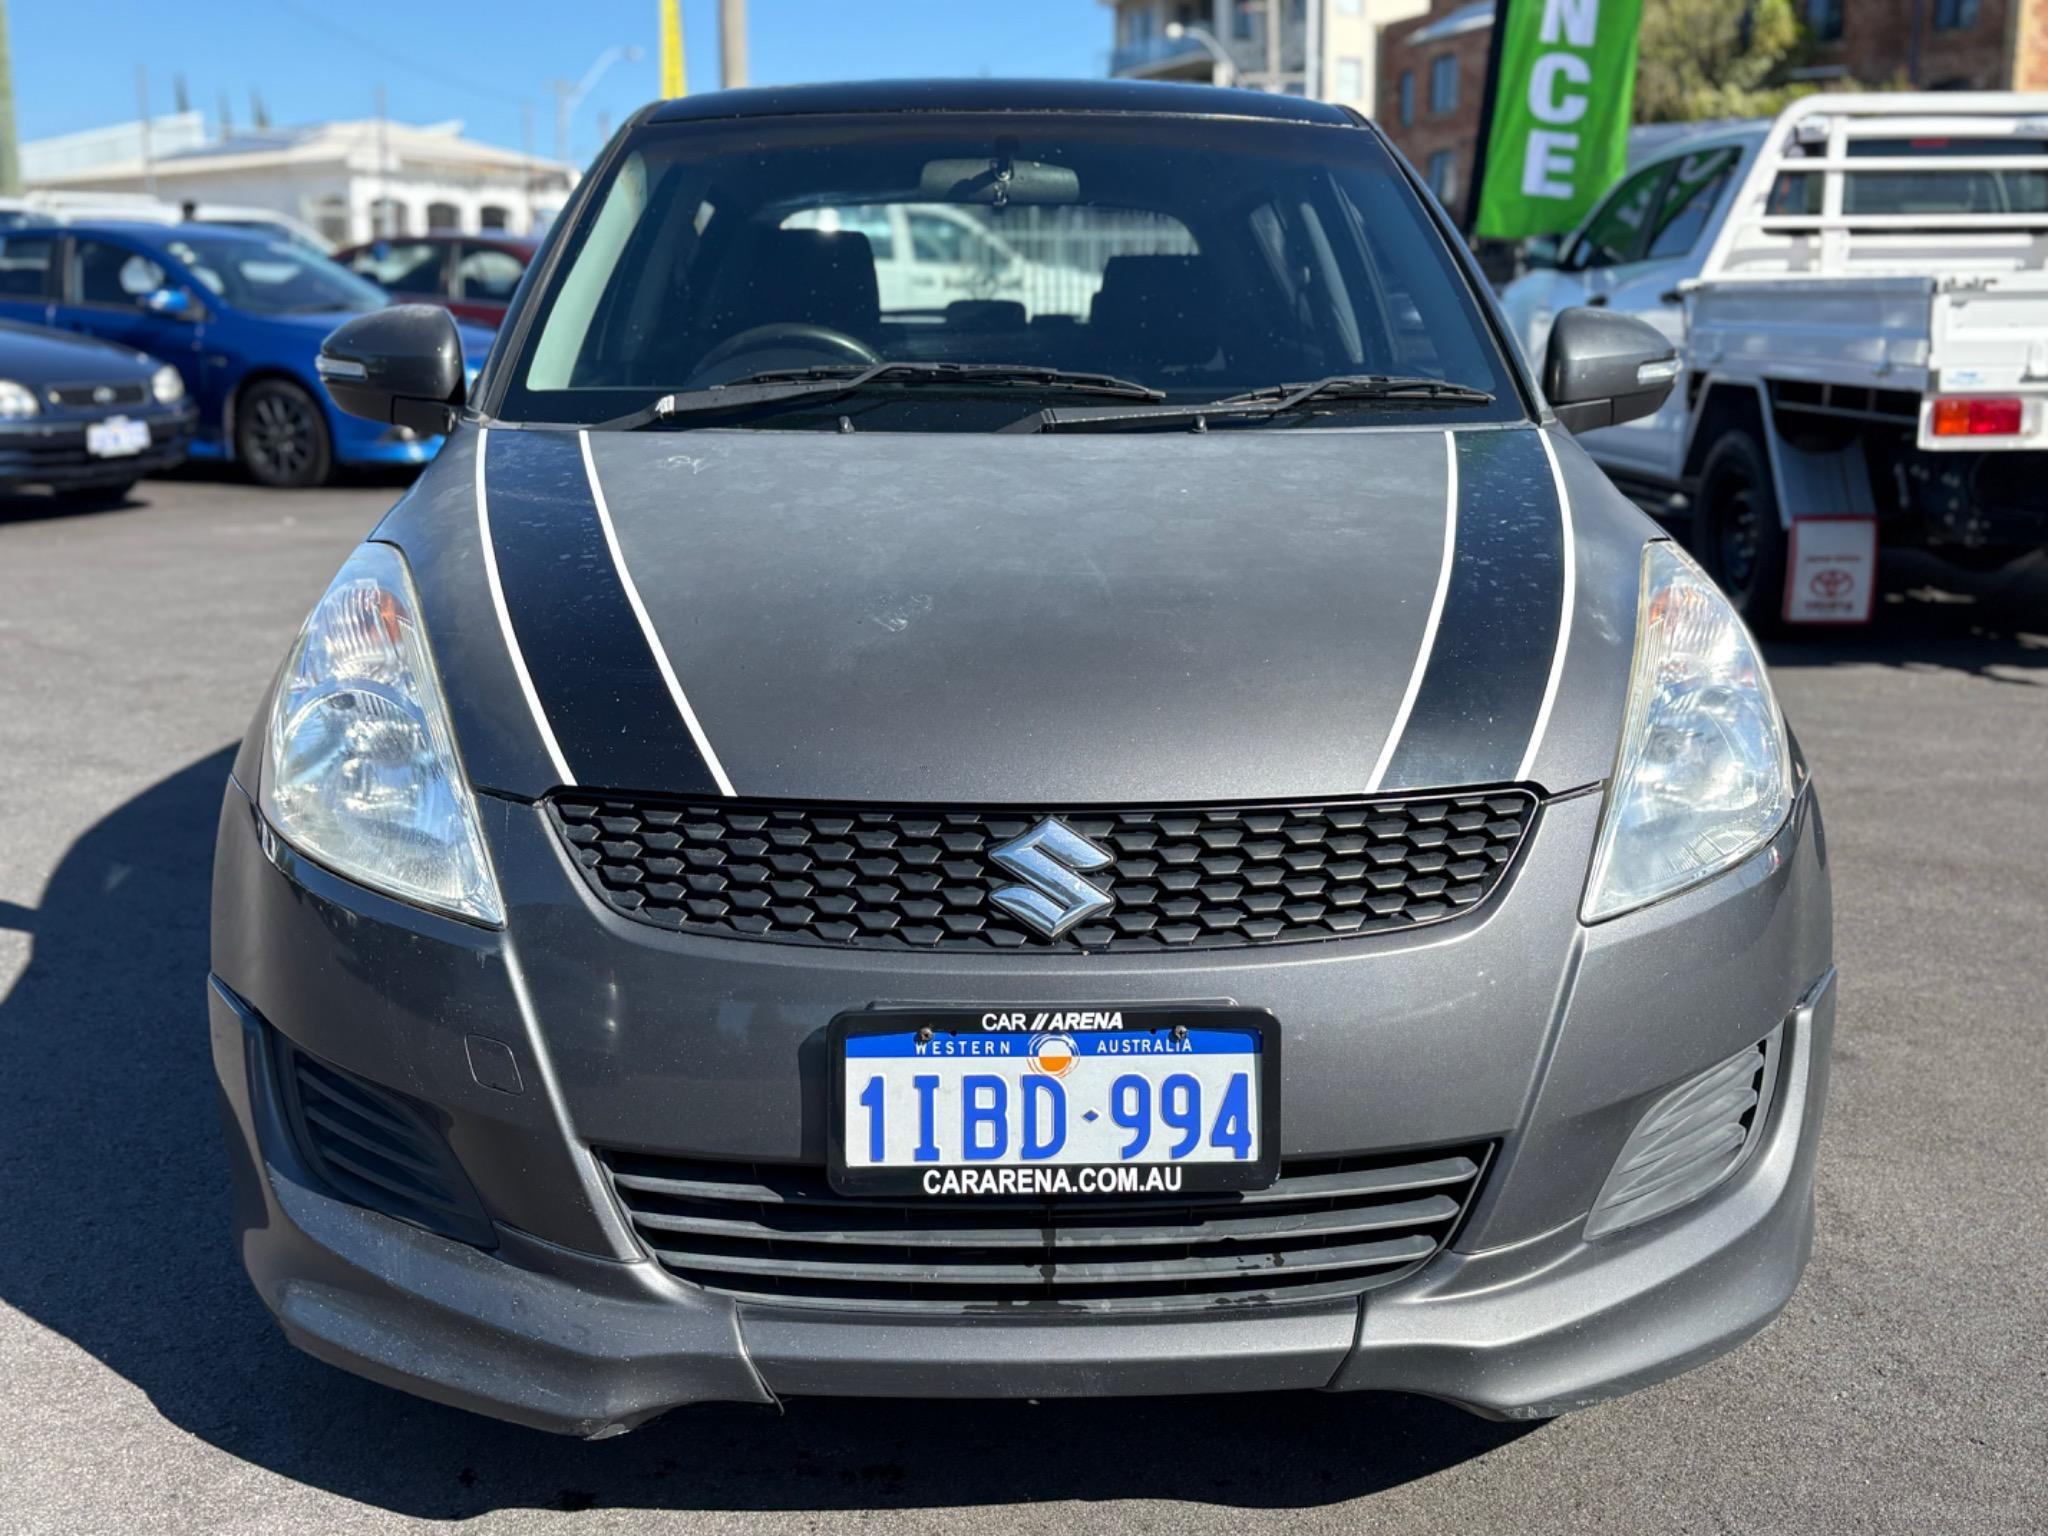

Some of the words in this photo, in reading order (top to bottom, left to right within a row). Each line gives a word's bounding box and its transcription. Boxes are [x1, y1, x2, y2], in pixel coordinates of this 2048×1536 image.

[981, 1013, 1027, 1031] CAR
[915, 1041, 1011, 1055] WESTERN
[1097, 1038, 1193, 1053] AUSTRALIA
[923, 1166, 1182, 1194] CARARENA.COM.AU
